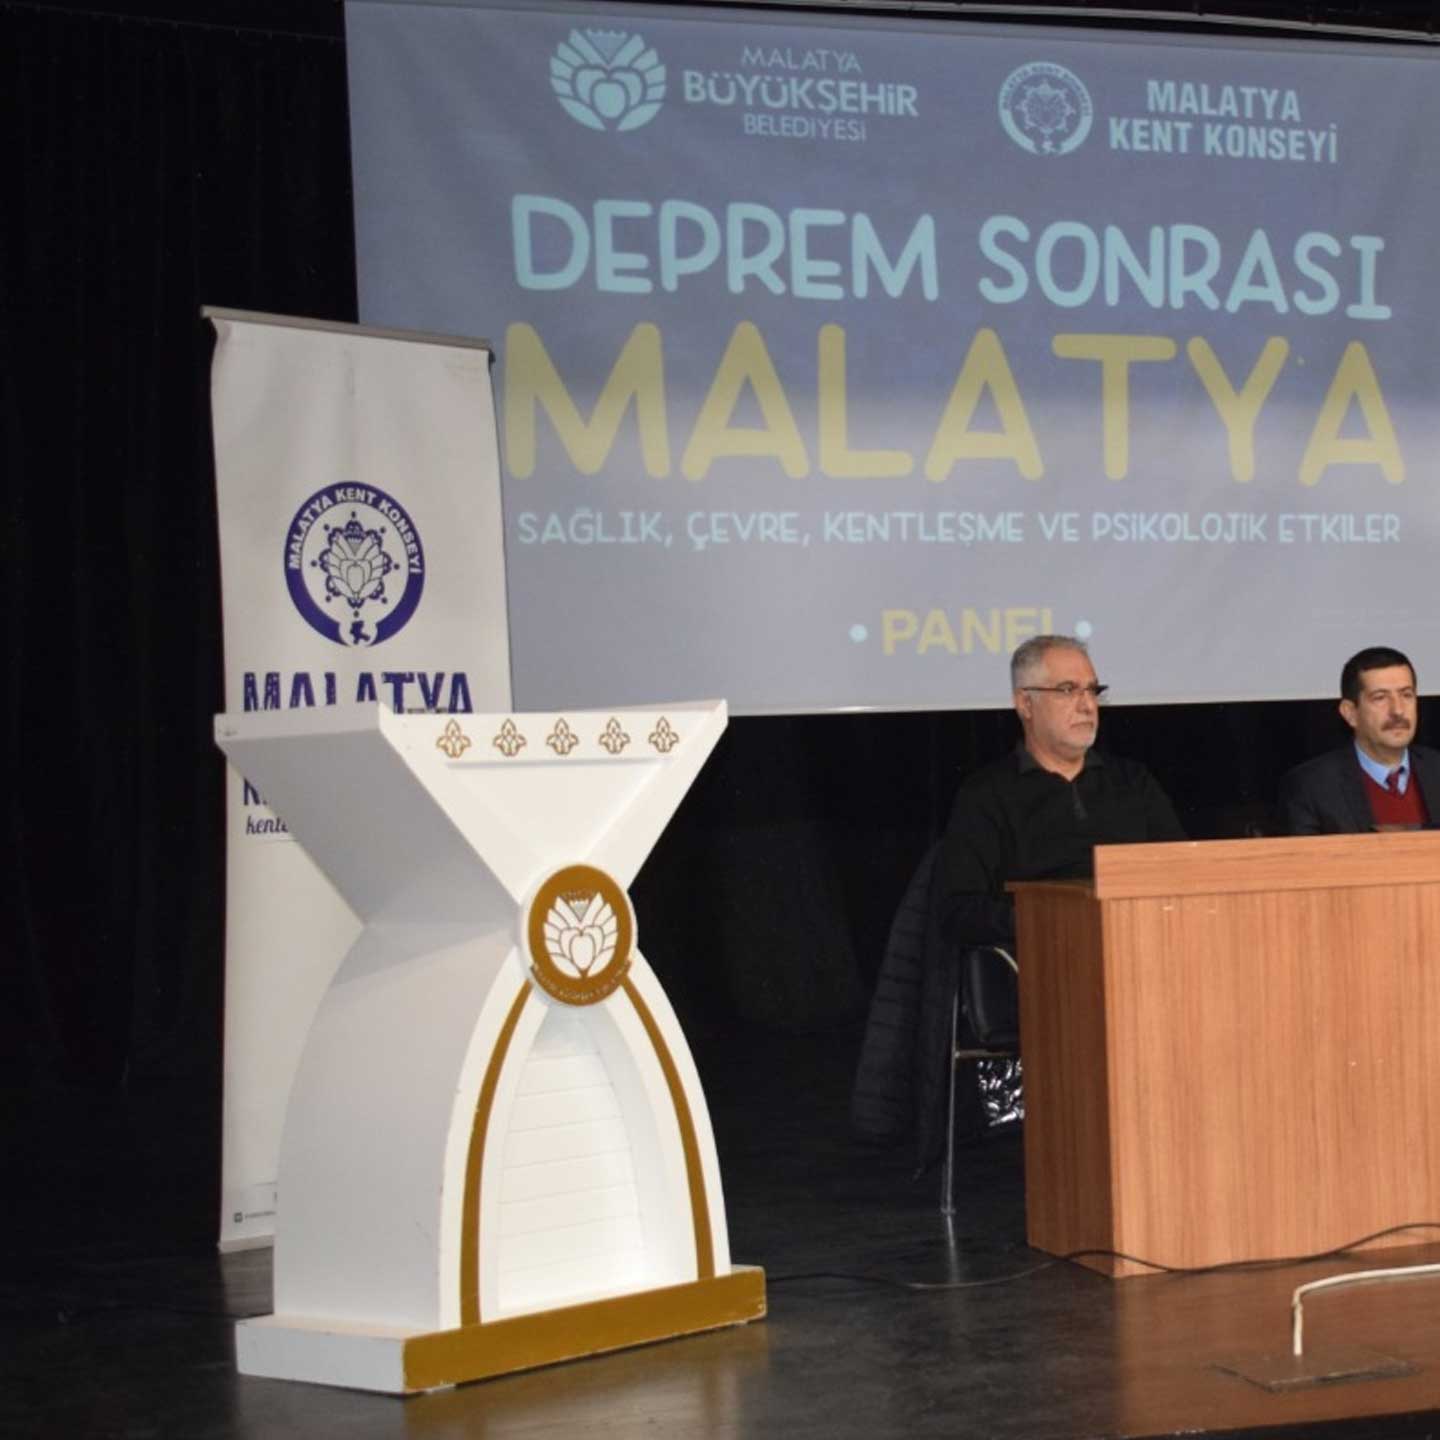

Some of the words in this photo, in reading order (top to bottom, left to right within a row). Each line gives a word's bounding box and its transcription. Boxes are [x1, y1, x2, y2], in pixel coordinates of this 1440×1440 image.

[741, 46, 862, 73] MALATYA
[1147, 80, 1301, 121] MALATYA
[1109, 117, 1192, 153] KENT
[1205, 122, 1337, 163] KONSEYİ
[512, 194, 938, 301] DEPREM
[978, 214, 1392, 320] SONRASI
[505, 321, 1405, 485] MALATYA
[288, 495, 333, 569] MALATYA
[335, 488, 377, 504] KENT
[517, 507, 673, 548] SAĞLIK,
[687, 511, 810, 550] ÇEVRE,
[824, 511, 1023, 547] KENTLEŞME
[1039, 511, 1080, 543] VE
